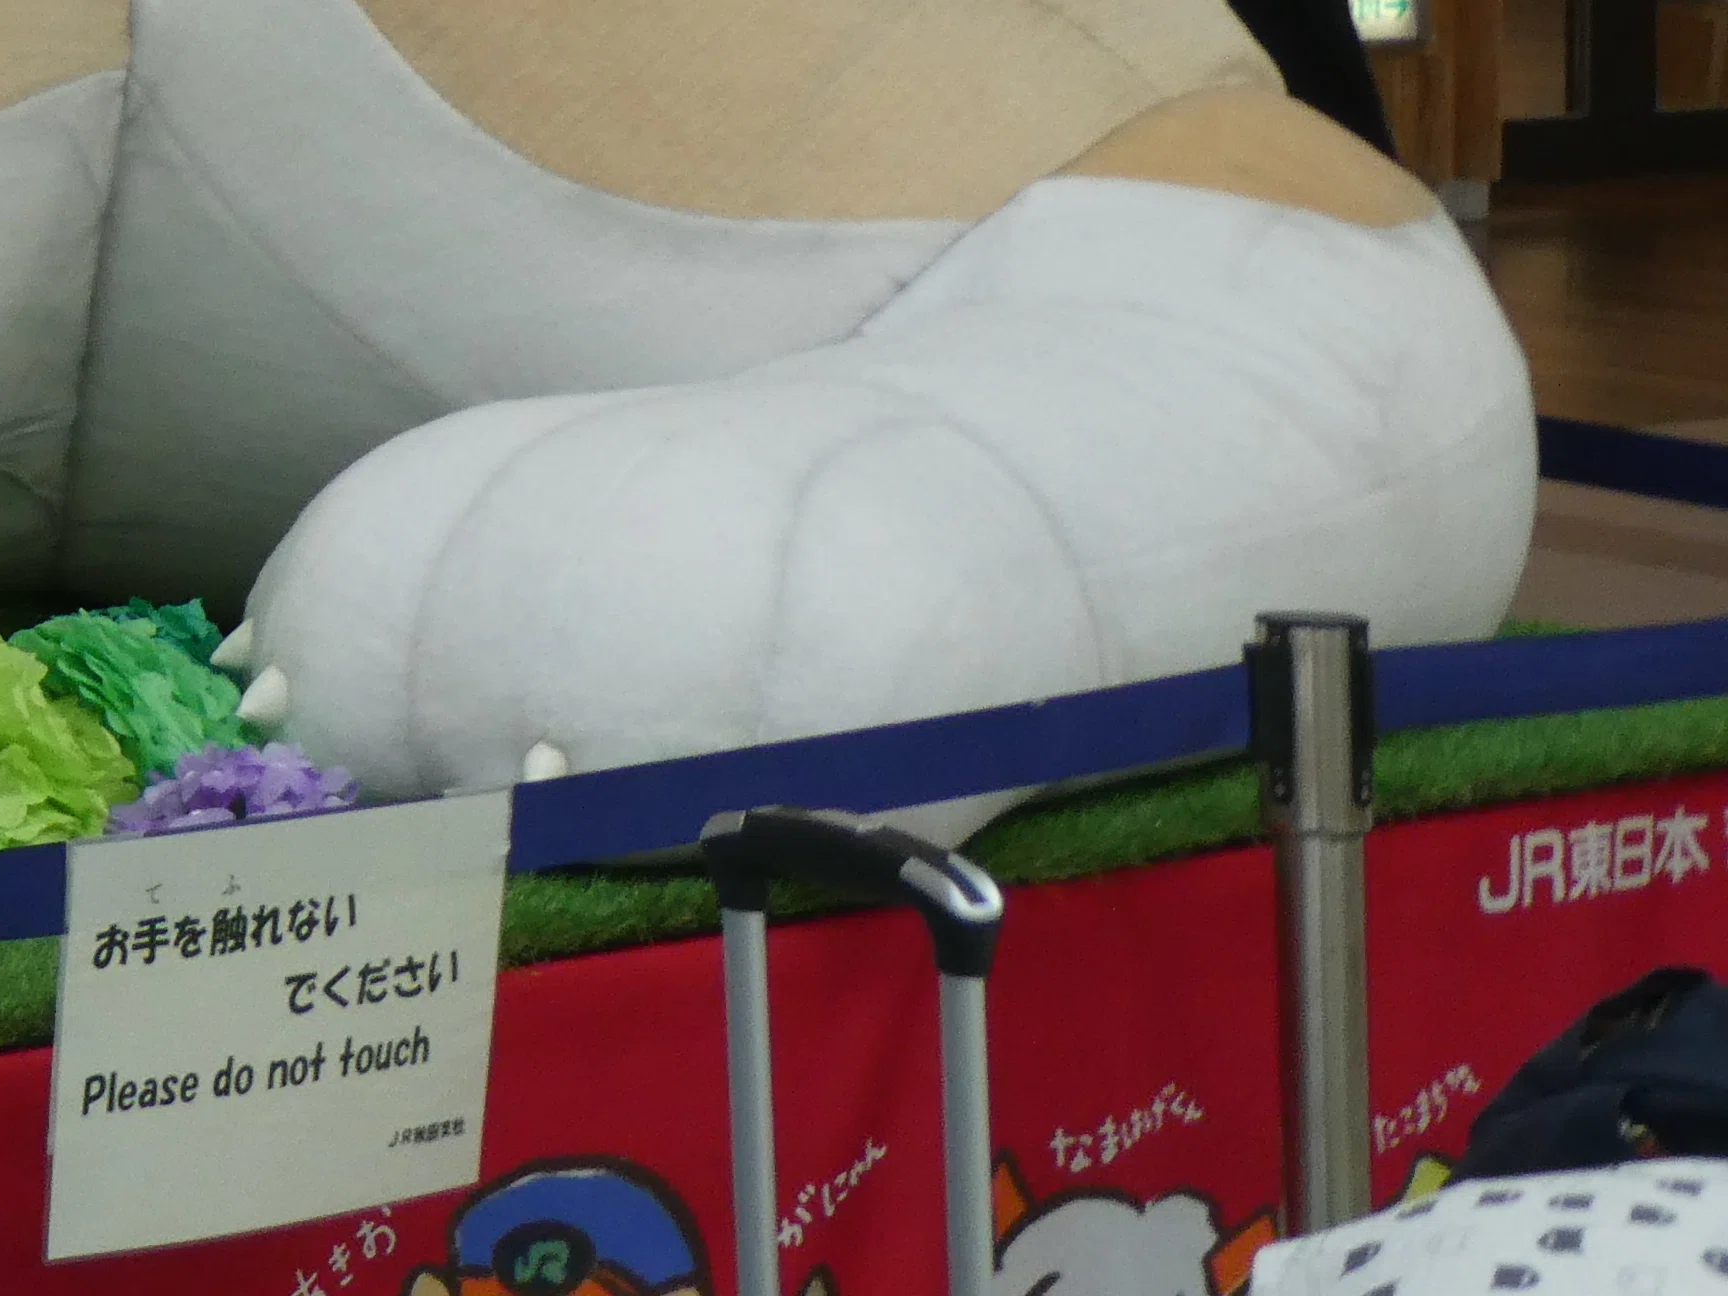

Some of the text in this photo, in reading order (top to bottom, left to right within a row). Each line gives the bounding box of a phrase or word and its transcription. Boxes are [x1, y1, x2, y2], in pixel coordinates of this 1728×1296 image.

[1478, 804, 1711, 915] JR東日本
[93, 893, 357, 969] お手を触れない
[284, 949, 459, 1015] でください
[81, 1024, 431, 1116] Please do not touch
